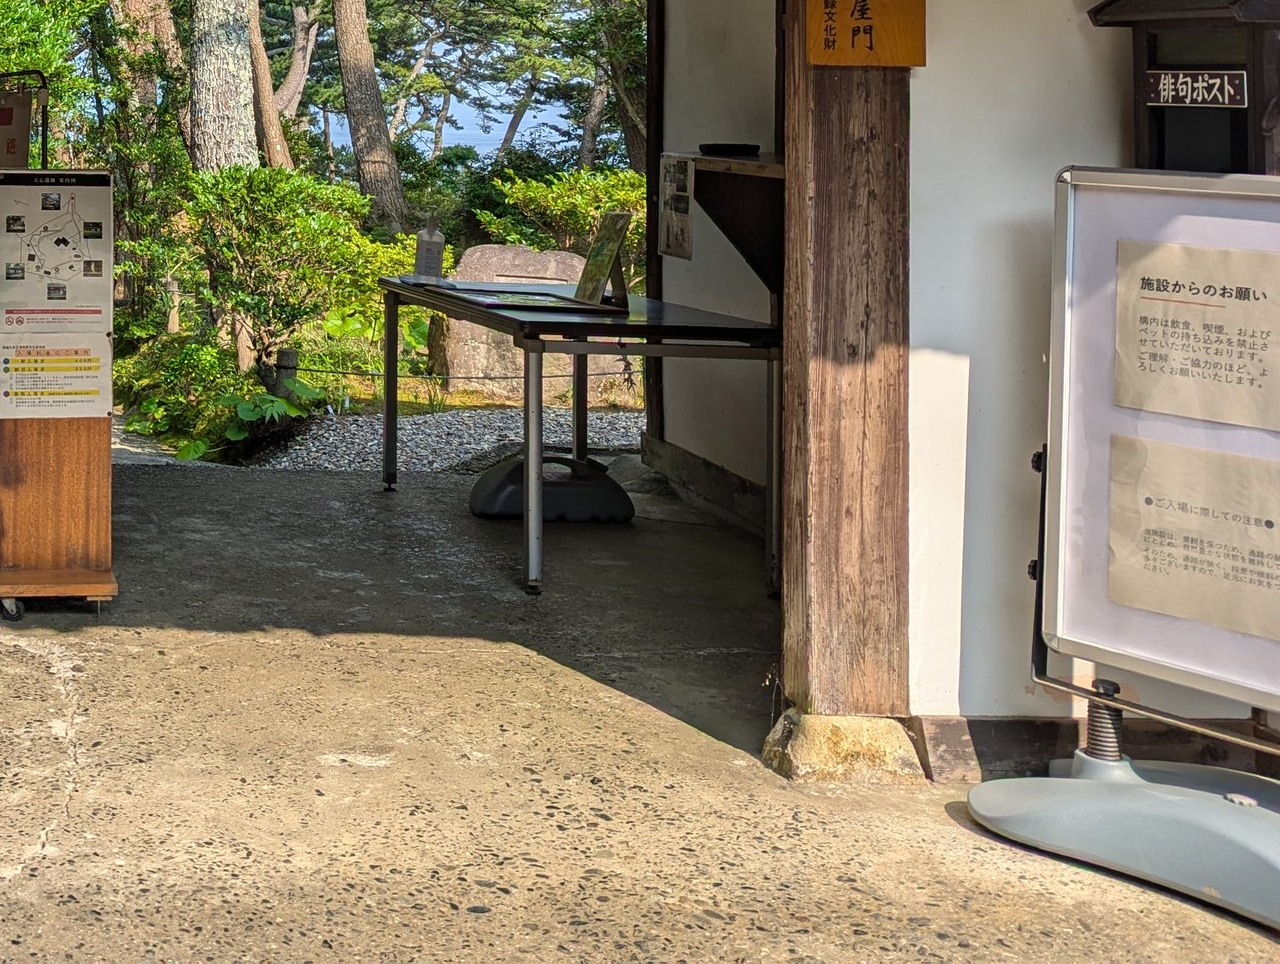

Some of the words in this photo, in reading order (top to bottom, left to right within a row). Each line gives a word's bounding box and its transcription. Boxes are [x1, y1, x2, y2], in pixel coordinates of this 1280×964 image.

[1158, 73, 1235, 105] 俳句ポスト
[1140, 276, 1267, 301] 施設からのお願い
[1139, 338, 1263, 363] せていただいております。
[1138, 362, 1262, 388] ろしくお願いいたします。
